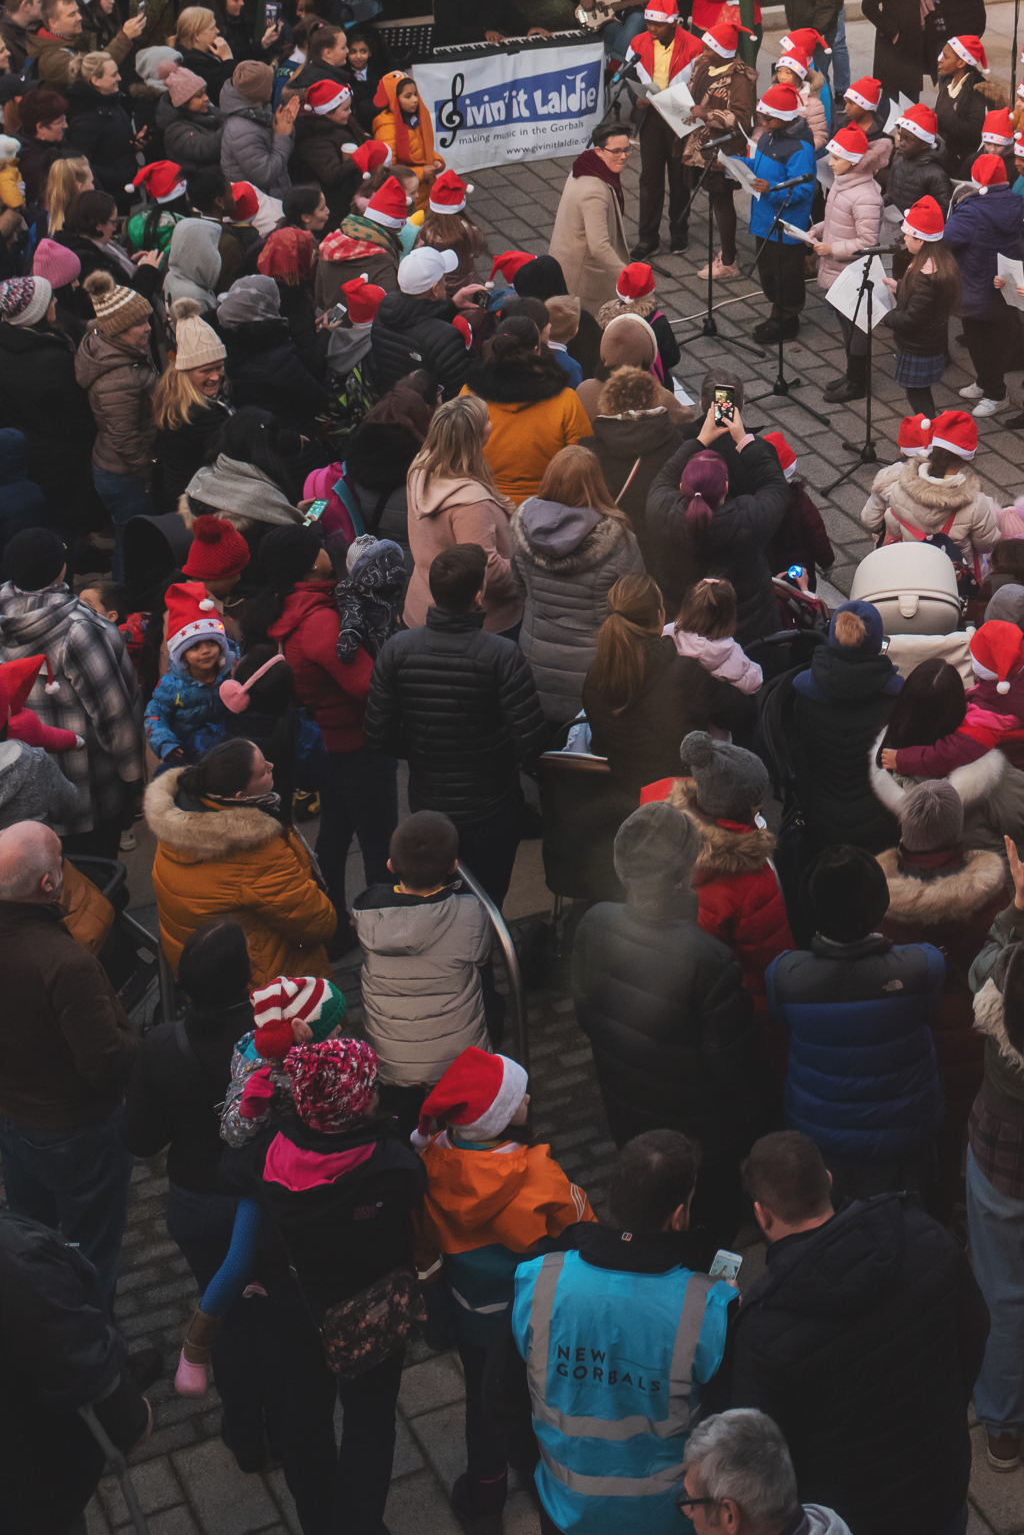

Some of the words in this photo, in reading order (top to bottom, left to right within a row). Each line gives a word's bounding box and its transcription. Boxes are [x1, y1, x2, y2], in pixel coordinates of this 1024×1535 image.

[511, 88, 530, 119] it
[533, 70, 597, 115] Laldie
[458, 133, 490, 146] making
[493, 129, 517, 141] music
[519, 127, 529, 137] in
[531, 125, 548, 136] the
[550, 119, 585, 134] Gorbals
[506, 134, 592, 155] www.givinitlaldie.or
[557, 1344, 606, 1365] NEW
[556, 1362, 661, 1392] GORBALS
